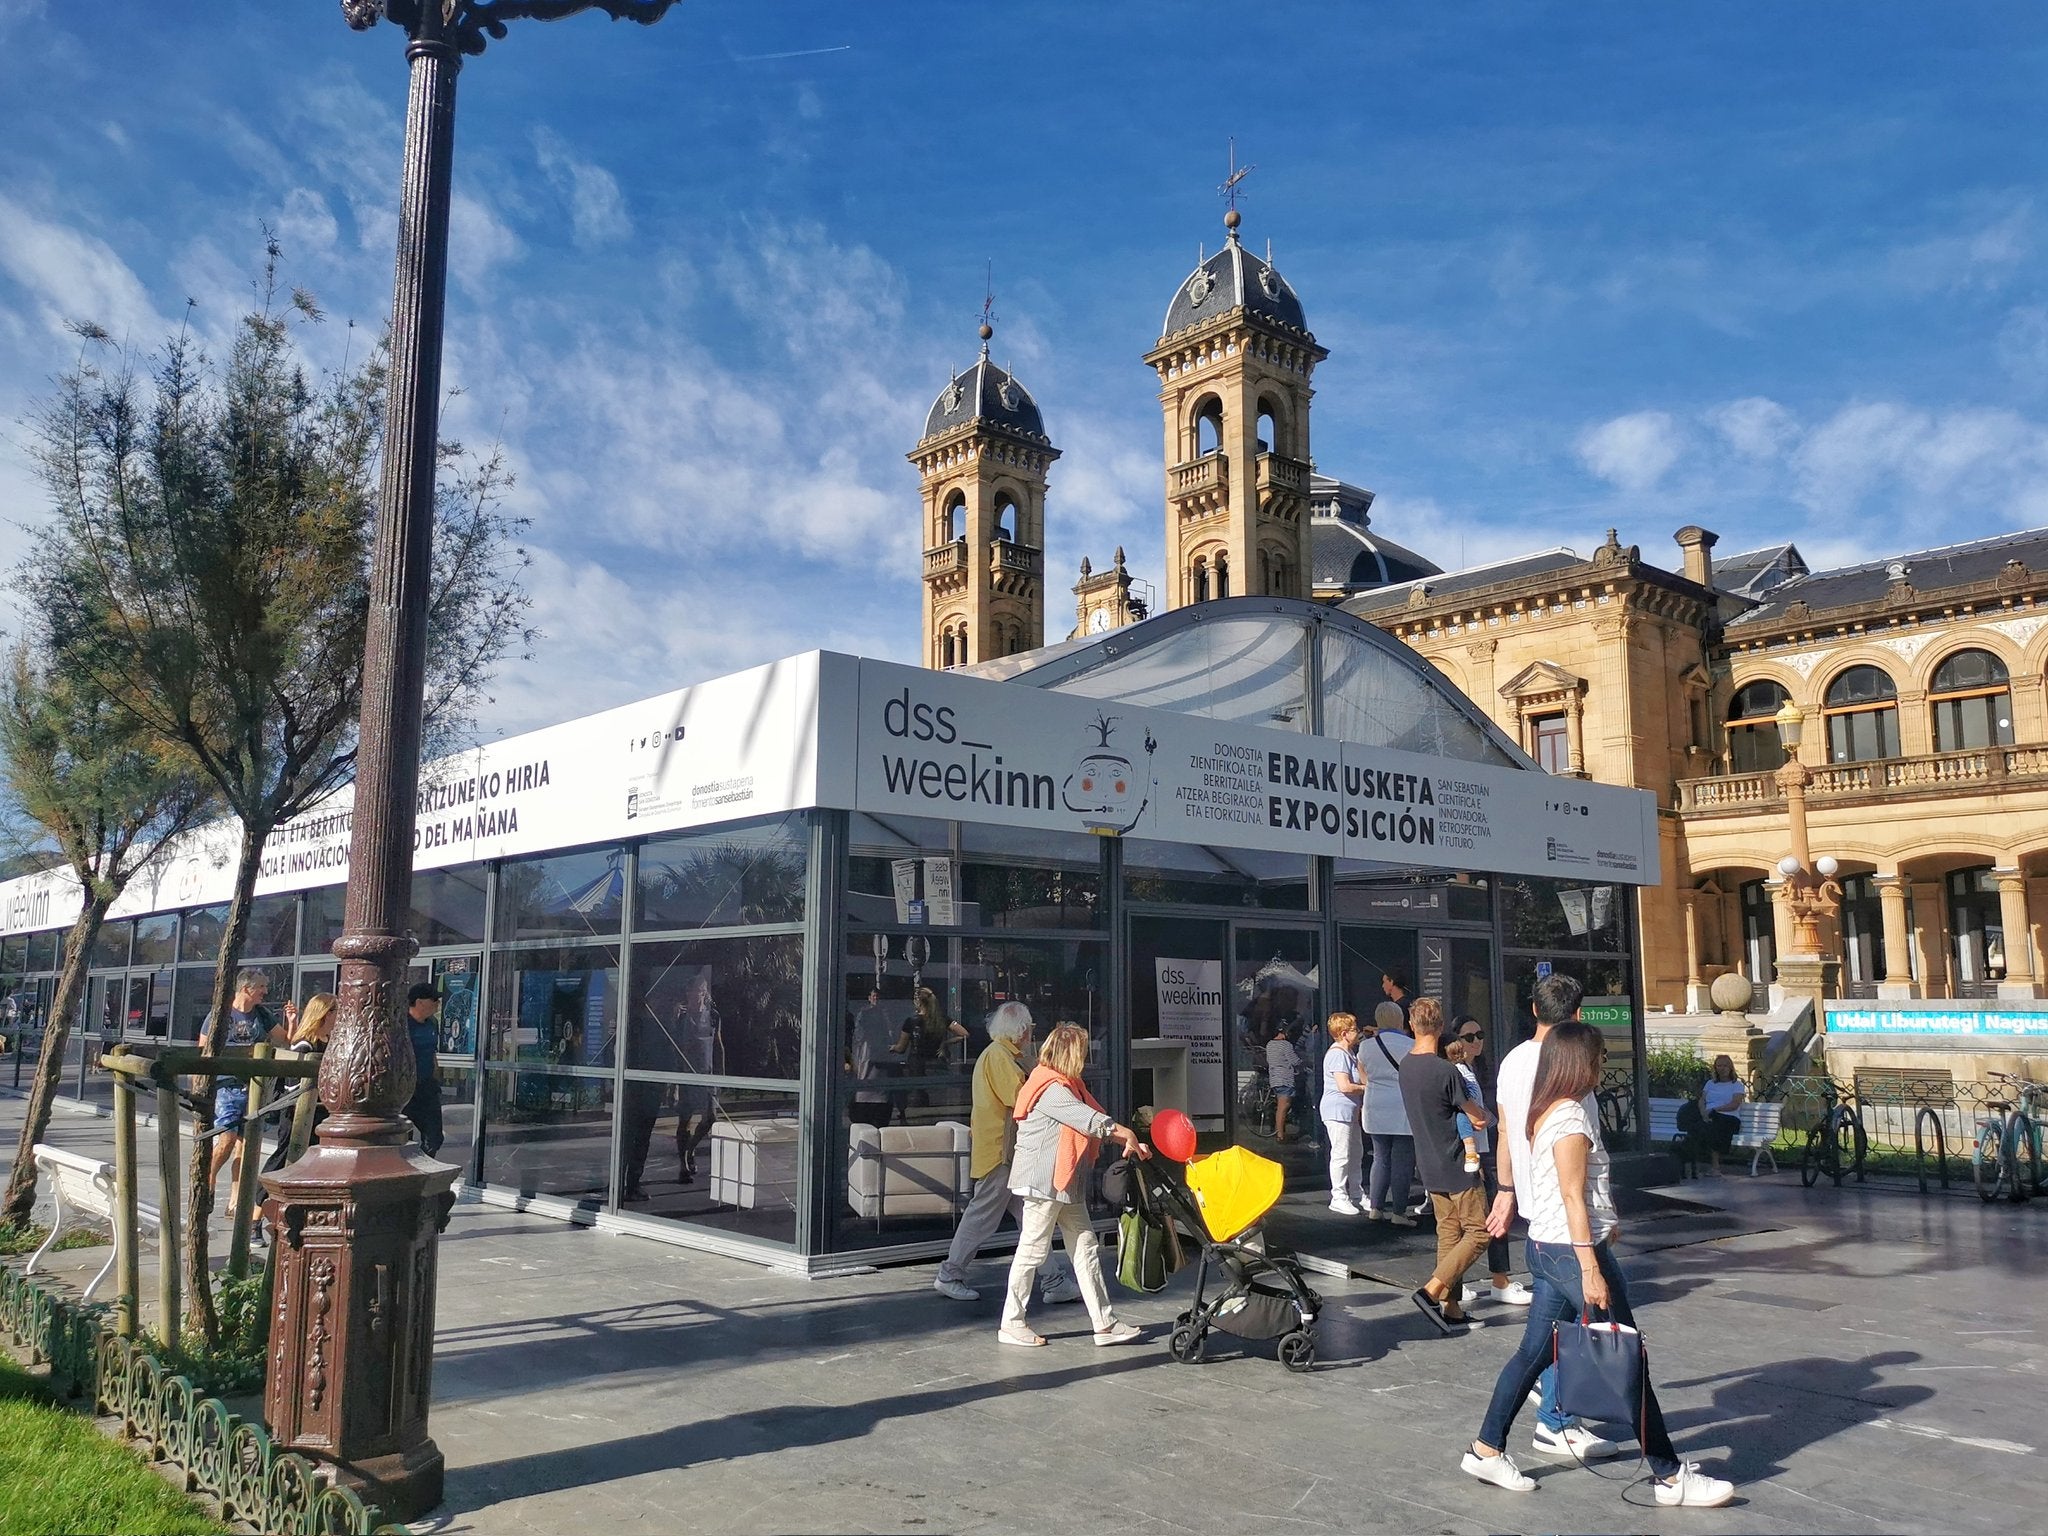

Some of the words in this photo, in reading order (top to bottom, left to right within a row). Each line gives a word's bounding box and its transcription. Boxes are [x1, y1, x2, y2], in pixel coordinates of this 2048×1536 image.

[1214, 743, 1263, 762] DONOSTIA
[1190, 755, 1246, 775] ZIENTIFIKOA
[1248, 764, 1264, 778] ETA
[416, 772, 500, 815] RKIZUNEKO
[506, 760, 550, 794] HIRIA
[882, 753, 1055, 811] weekinn
[1203, 774, 1263, 793] BERRITZAILEA:
[1268, 752, 1435, 806] ERAKUSKETA
[1437, 779, 1453, 791] SAN
[1454, 781, 1490, 797] SEBASTIÁN
[1175, 786, 1210, 802] ATZERA
[1212, 791, 1264, 809] BEGIRAKOA
[1477, 799, 1481, 809] E
[1186, 804, 1203, 818] ETA
[1205, 806, 1264, 825] ETORKIZUNA.
[1269, 796, 1434, 845] EXPOSICIÓN
[290, 821, 306, 843] ETA
[310, 811, 353, 839] BERRIKU
[425, 822, 448, 849] DEL
[452, 806, 518, 843] MAÑANA
[1439, 821, 1492, 838] RETROSPECTIVA
[1439, 836, 1444, 847] Y
[1445, 836, 1476, 850] FUTURO.
[258, 856, 278, 879] NCIA
[281, 855, 286, 875] E
[1161, 986, 1221, 1005] weekinn
[1836, 1013, 1875, 1028] Udal
[1881, 1014, 1979, 1033] Liburutegi
